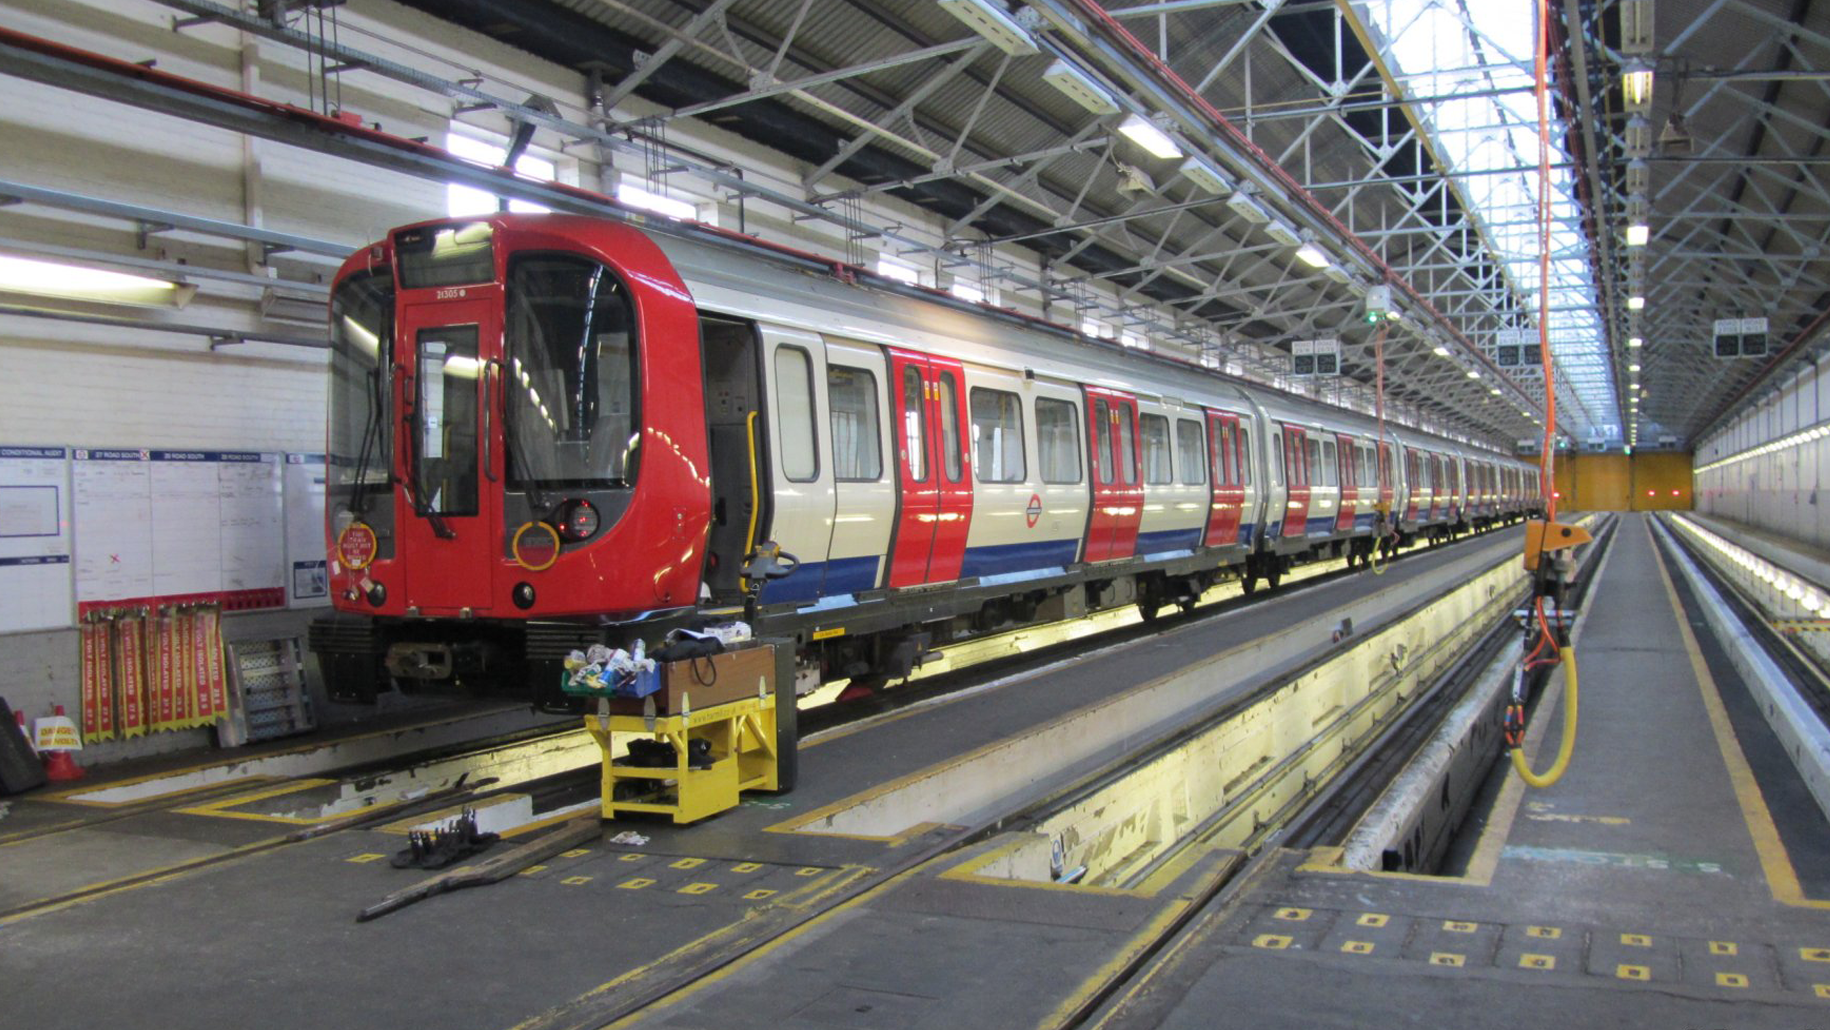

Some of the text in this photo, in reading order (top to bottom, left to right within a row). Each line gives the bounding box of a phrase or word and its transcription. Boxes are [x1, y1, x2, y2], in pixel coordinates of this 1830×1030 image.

[436, 289, 458, 299] 21305
[126, 657, 135, 695] ISOLATED
[197, 649, 206, 686] ISOLATED
